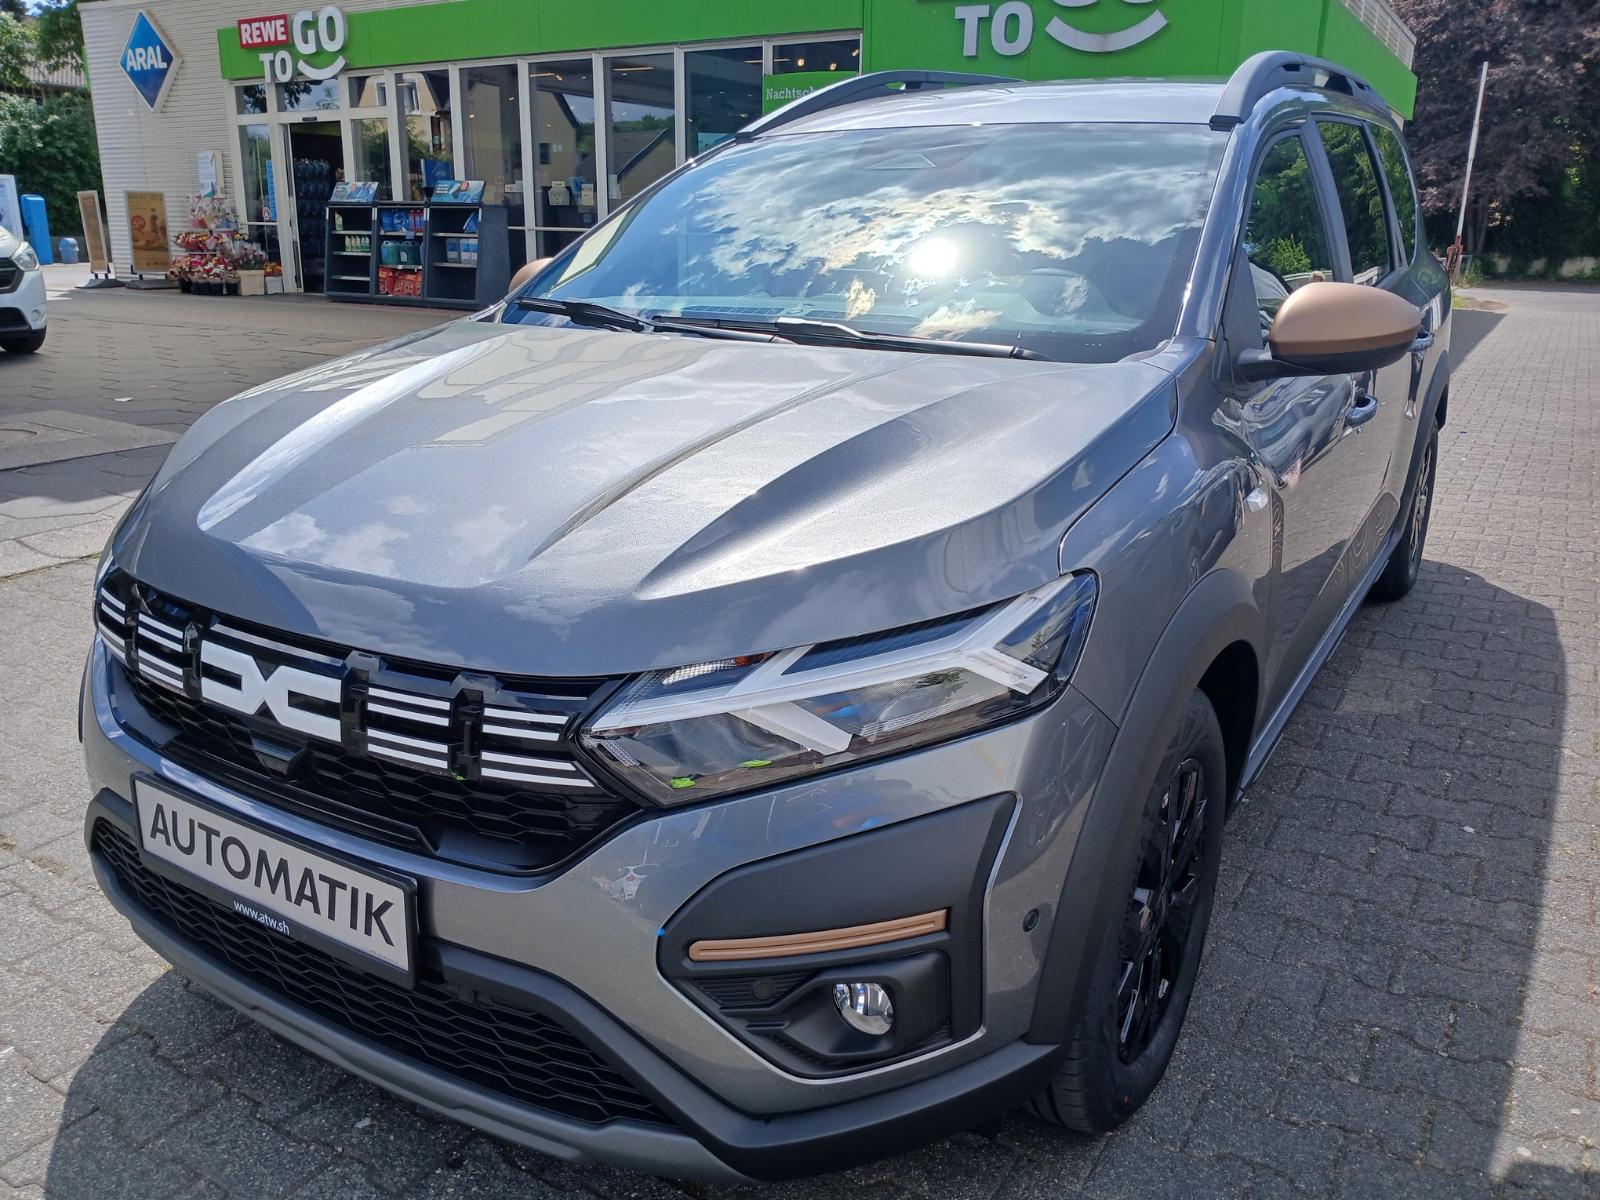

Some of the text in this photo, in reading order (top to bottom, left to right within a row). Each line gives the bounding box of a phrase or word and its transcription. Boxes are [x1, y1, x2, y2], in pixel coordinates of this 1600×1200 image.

[240, 5, 345, 55] REWE GO
[954, 1, 1033, 56] TO
[126, 45, 168, 72] ARAL
[259, 50, 293, 83] TO
[150, 803, 395, 947] AUTOMATIK
[233, 900, 290, 936] www.atw.sh
